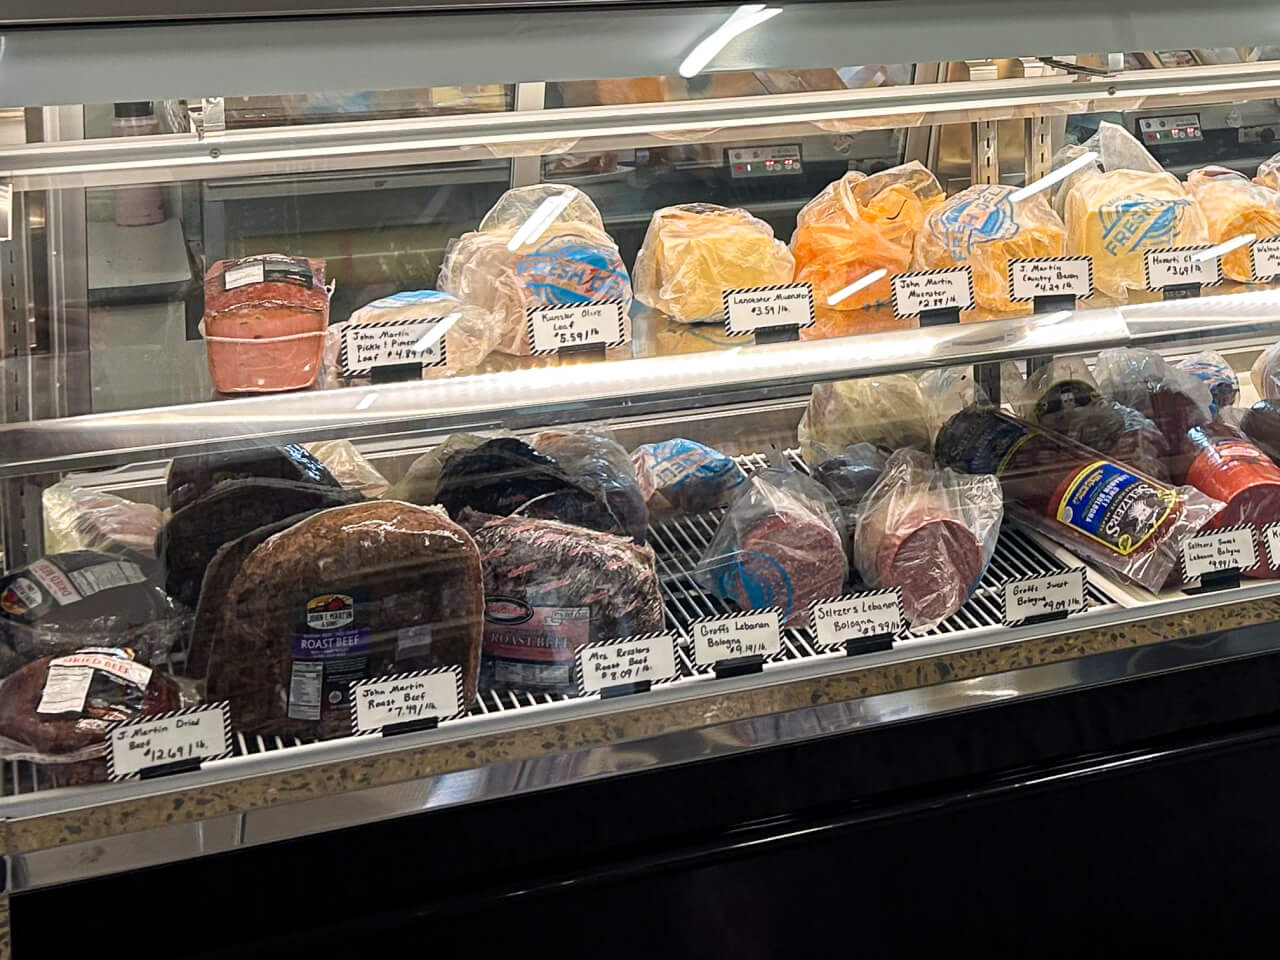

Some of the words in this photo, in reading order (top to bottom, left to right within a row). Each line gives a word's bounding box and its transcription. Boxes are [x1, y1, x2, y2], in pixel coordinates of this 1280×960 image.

[517, 260, 584, 283] FRESH
[1031, 264, 1062, 273] Martin
[900, 279, 920, 289] John
[924, 278, 953, 287] Martin
[1022, 275, 1053, 285] Country
[1056, 272, 1079, 280] Bacon
[734, 296, 771, 305] Lancaster
[773, 293, 808, 301] Muenster
[908, 290, 947, 299] Muenster
[553, 321, 574, 332] Loaf
[352, 329, 375, 340] John
[378, 329, 410, 340] Martin
[357, 352, 380, 365] Loaf
[1218, 538, 1236, 546] Sweet
[1189, 552, 1214, 561] Lebanon
[1217, 547, 1241, 556] Bologna
[1046, 581, 1069, 590] Sweet
[1017, 596, 1047, 607] Bologna
[818, 606, 859, 620] Seltzers
[862, 600, 901, 614] Lebanon
[735, 621, 770, 631] Lebanon
[834, 618, 874, 632] Bologna
[301, 640, 334, 649] ROAST
[336, 635, 360, 647] BEEF
[707, 637, 742, 649] Bologna
[64, 657, 102, 665] DRIED
[104, 661, 130, 675] BEEF
[595, 662, 620, 672] Roast
[629, 657, 648, 667] Beef
[363, 689, 386, 698] John
[389, 683, 424, 694] Martin
[368, 699, 395, 710] Roast
[403, 692, 426, 702] Beef
[117, 731, 129, 740] J.
[131, 726, 168, 739] Martin
[176, 718, 201, 729] Dried
[129, 739, 151, 751] Beef
